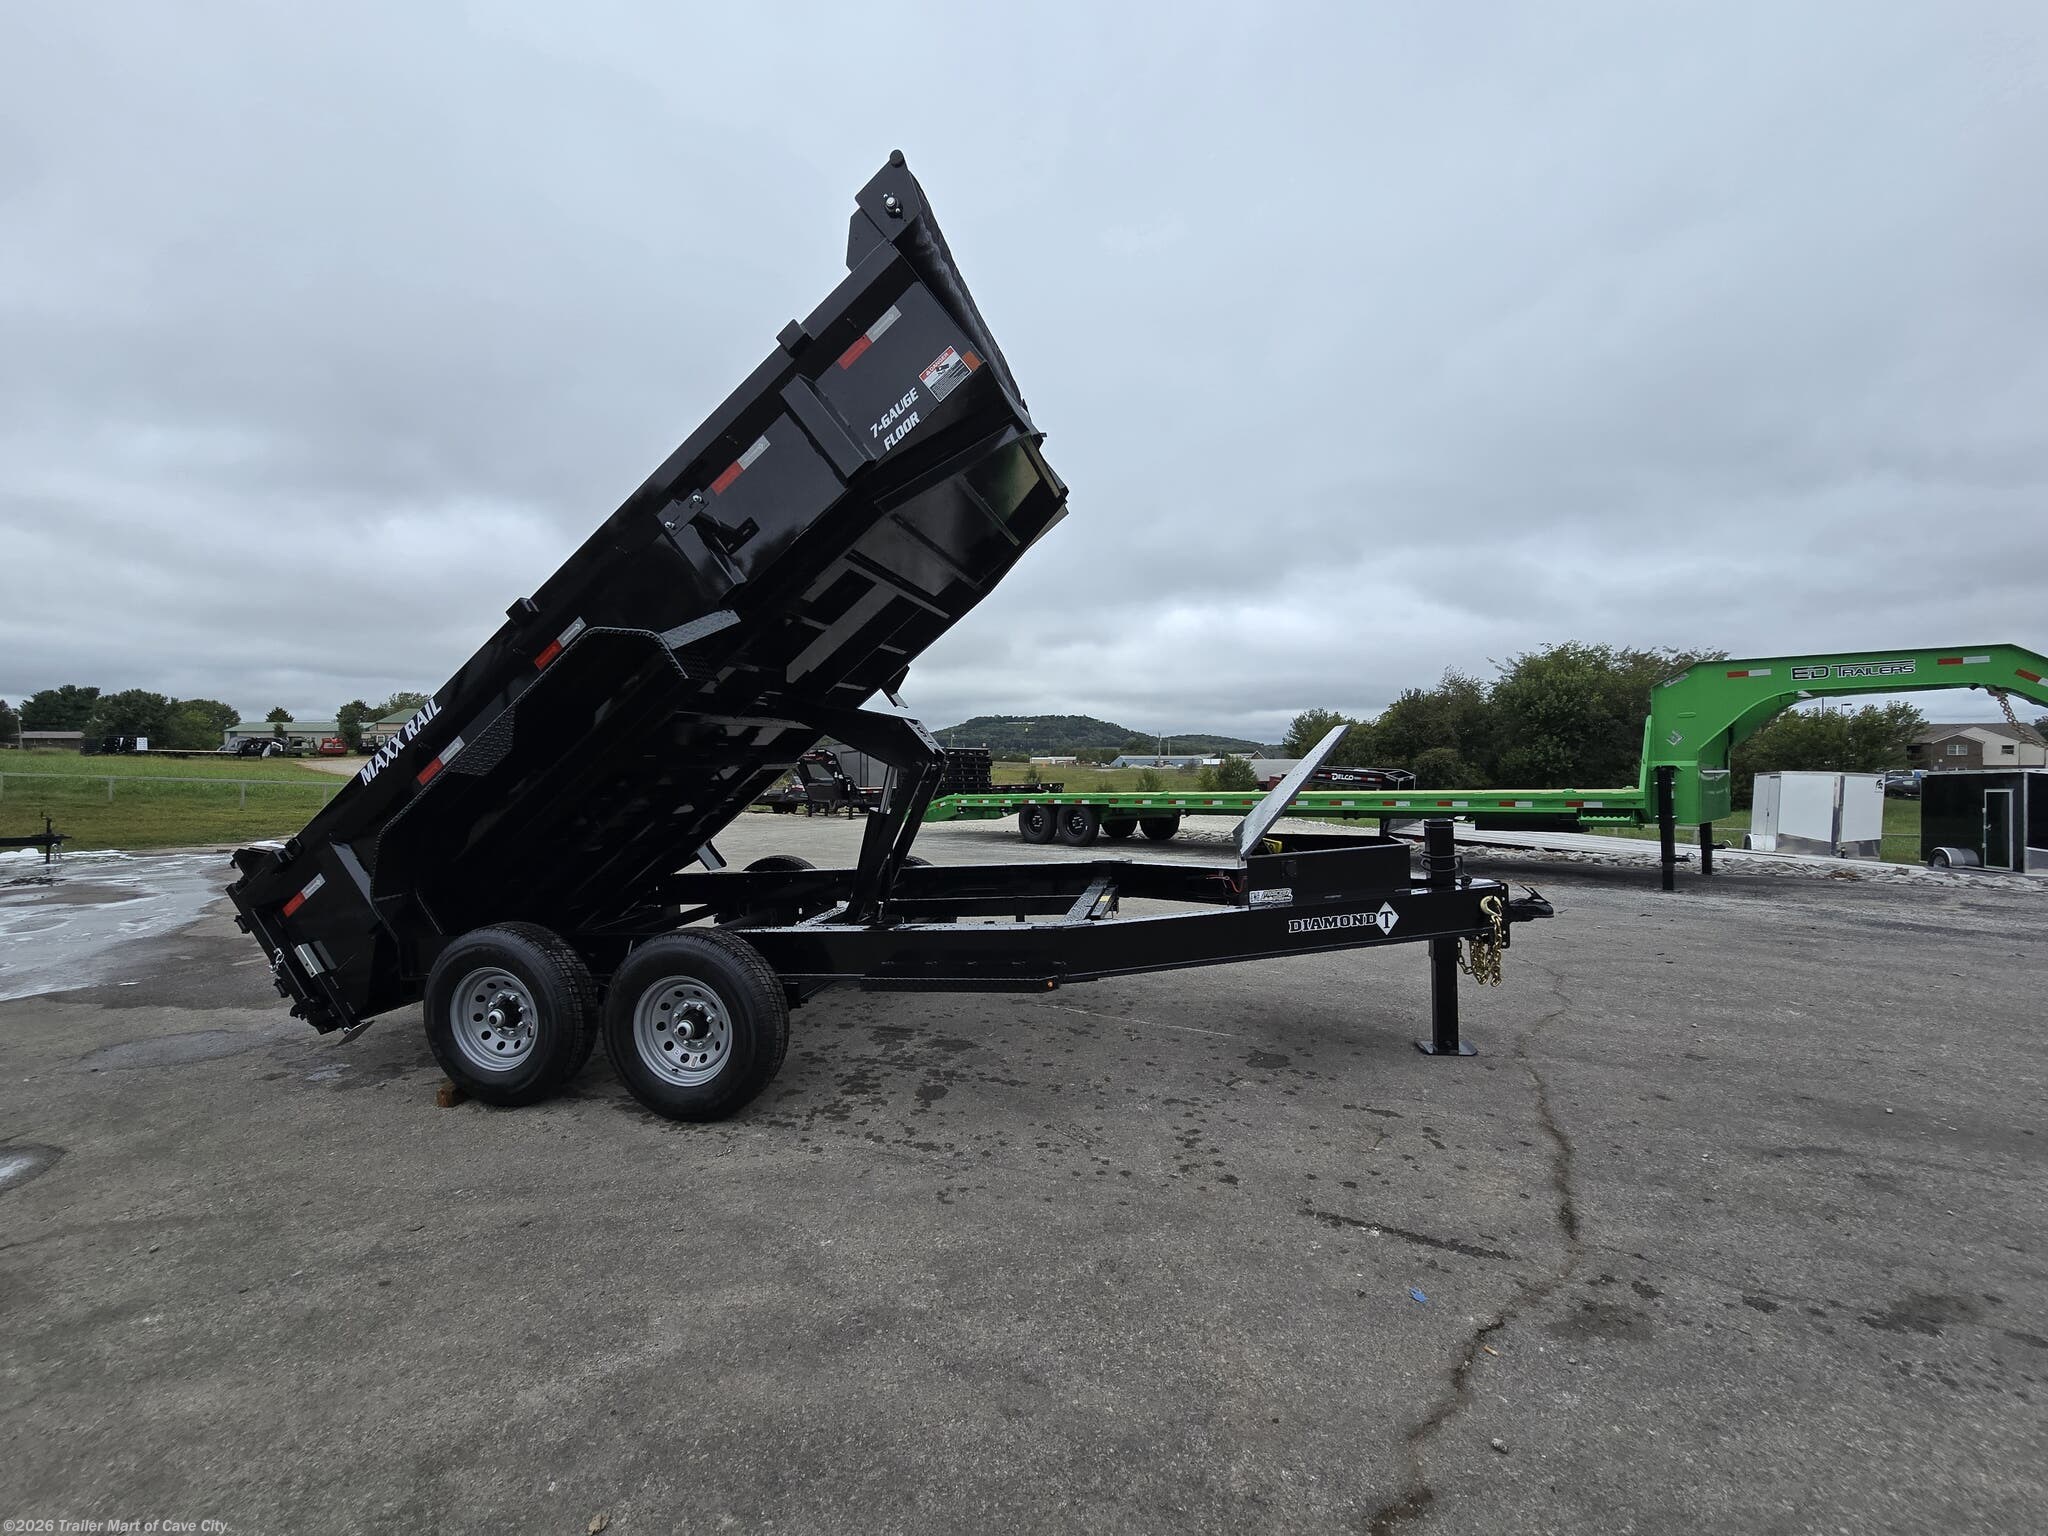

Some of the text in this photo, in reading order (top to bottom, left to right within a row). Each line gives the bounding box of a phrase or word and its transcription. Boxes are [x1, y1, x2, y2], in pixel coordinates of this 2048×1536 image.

[870, 387, 919, 438] 7-GAUGE
[883, 411, 920, 451] FLOOR
[1791, 659, 1916, 681] ED TRAILERS
[360, 698, 442, 787] MAXX RAIL
[1331, 773, 1354, 781] DELCO
[1288, 910, 1393, 933] DIAMOND T
